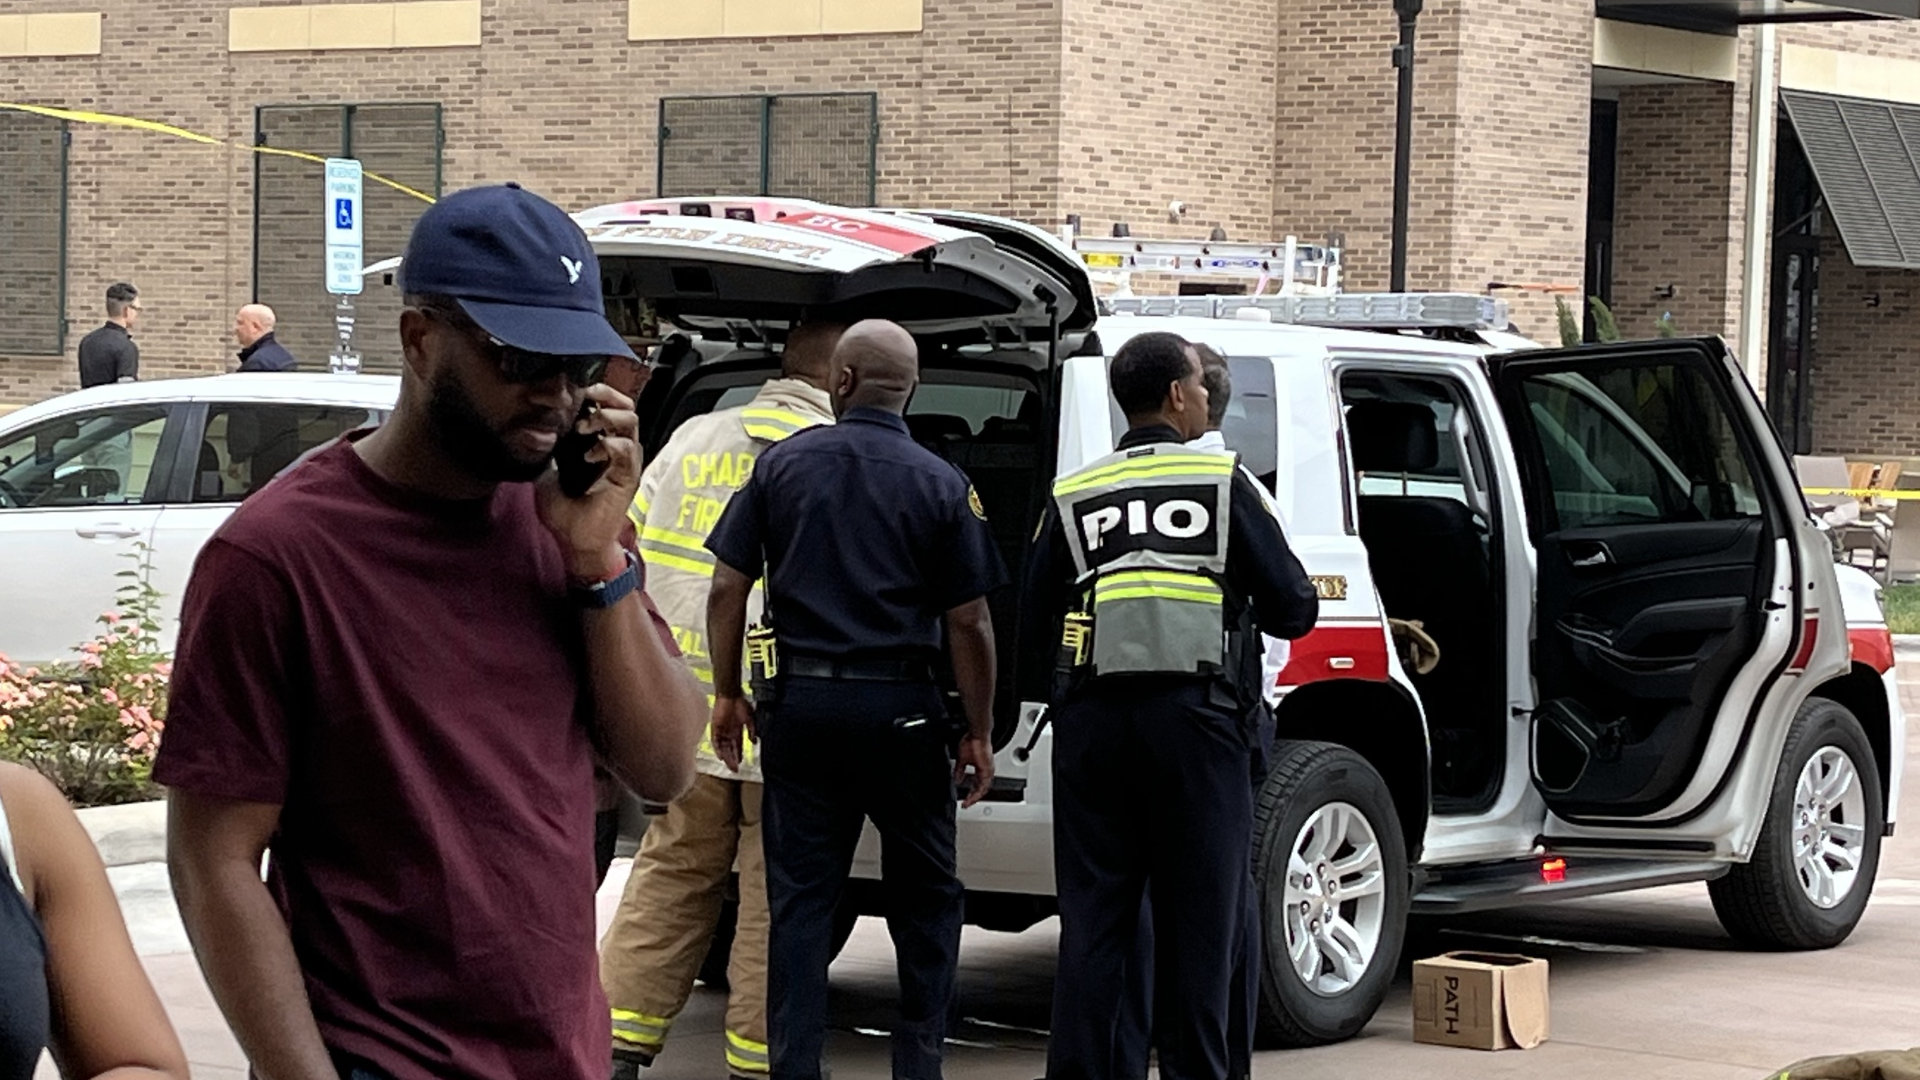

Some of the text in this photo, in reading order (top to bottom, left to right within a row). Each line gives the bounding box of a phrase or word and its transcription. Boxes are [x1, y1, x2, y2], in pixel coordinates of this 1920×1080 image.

[801, 214, 867, 232] BC
[676, 494, 727, 535] FIR
[1081, 499, 1210, 552] PIO
[1444, 975, 1460, 1035] PATH
